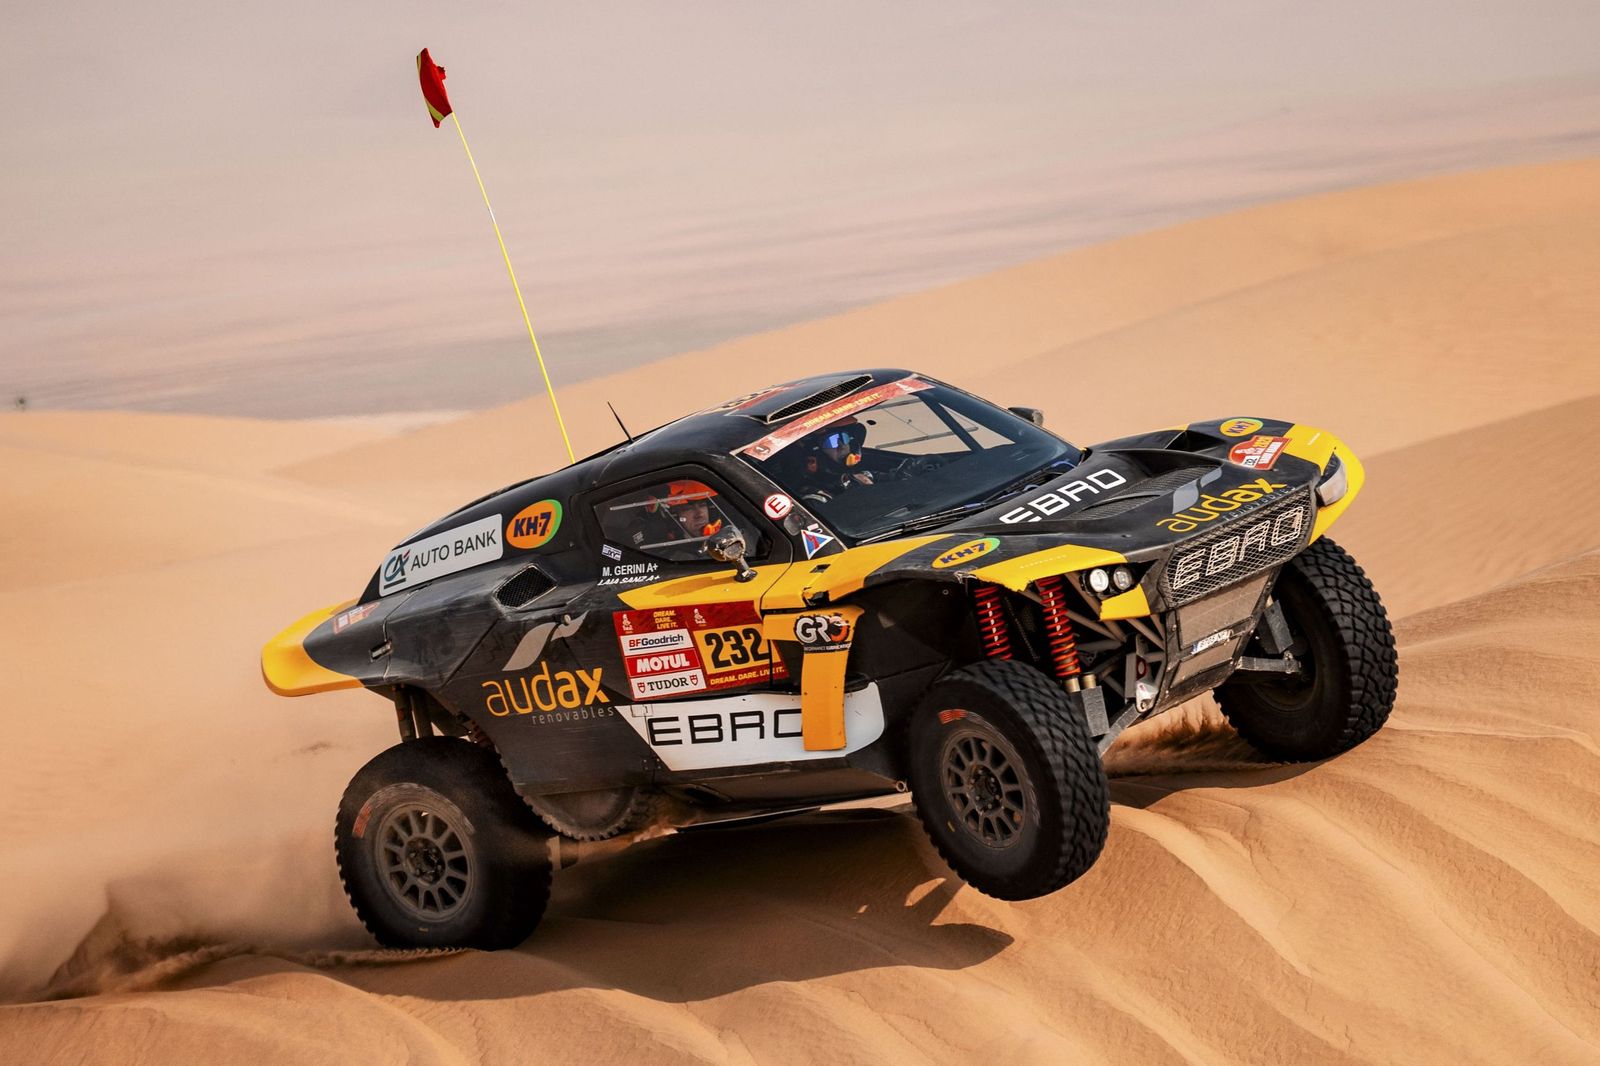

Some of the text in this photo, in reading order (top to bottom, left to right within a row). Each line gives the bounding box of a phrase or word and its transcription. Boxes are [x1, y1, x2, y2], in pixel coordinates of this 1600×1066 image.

[768, 496, 787, 514] E
[999, 469, 1126, 525] EBRO
[1156, 478, 1287, 532] audax
[513, 512, 552, 537] KH-7
[411, 544, 450, 571] AUTO
[454, 529, 497, 557] BANK
[939, 542, 986, 564] KH-7
[1173, 506, 1304, 590] EBRO
[602, 562, 659, 577] M. GERINI A+
[653, 610, 677, 618] DREAM.
[629, 634, 684, 648] BFGoodrich
[704, 627, 771, 669] 232
[636, 653, 691, 673] MOTUL
[647, 677, 689, 691] TUDOR
[710, 676, 738, 685] DREAM.
[738, 671, 760, 681] DARE.
[481, 661, 610, 717] audax
[532, 706, 614, 725] renovables
